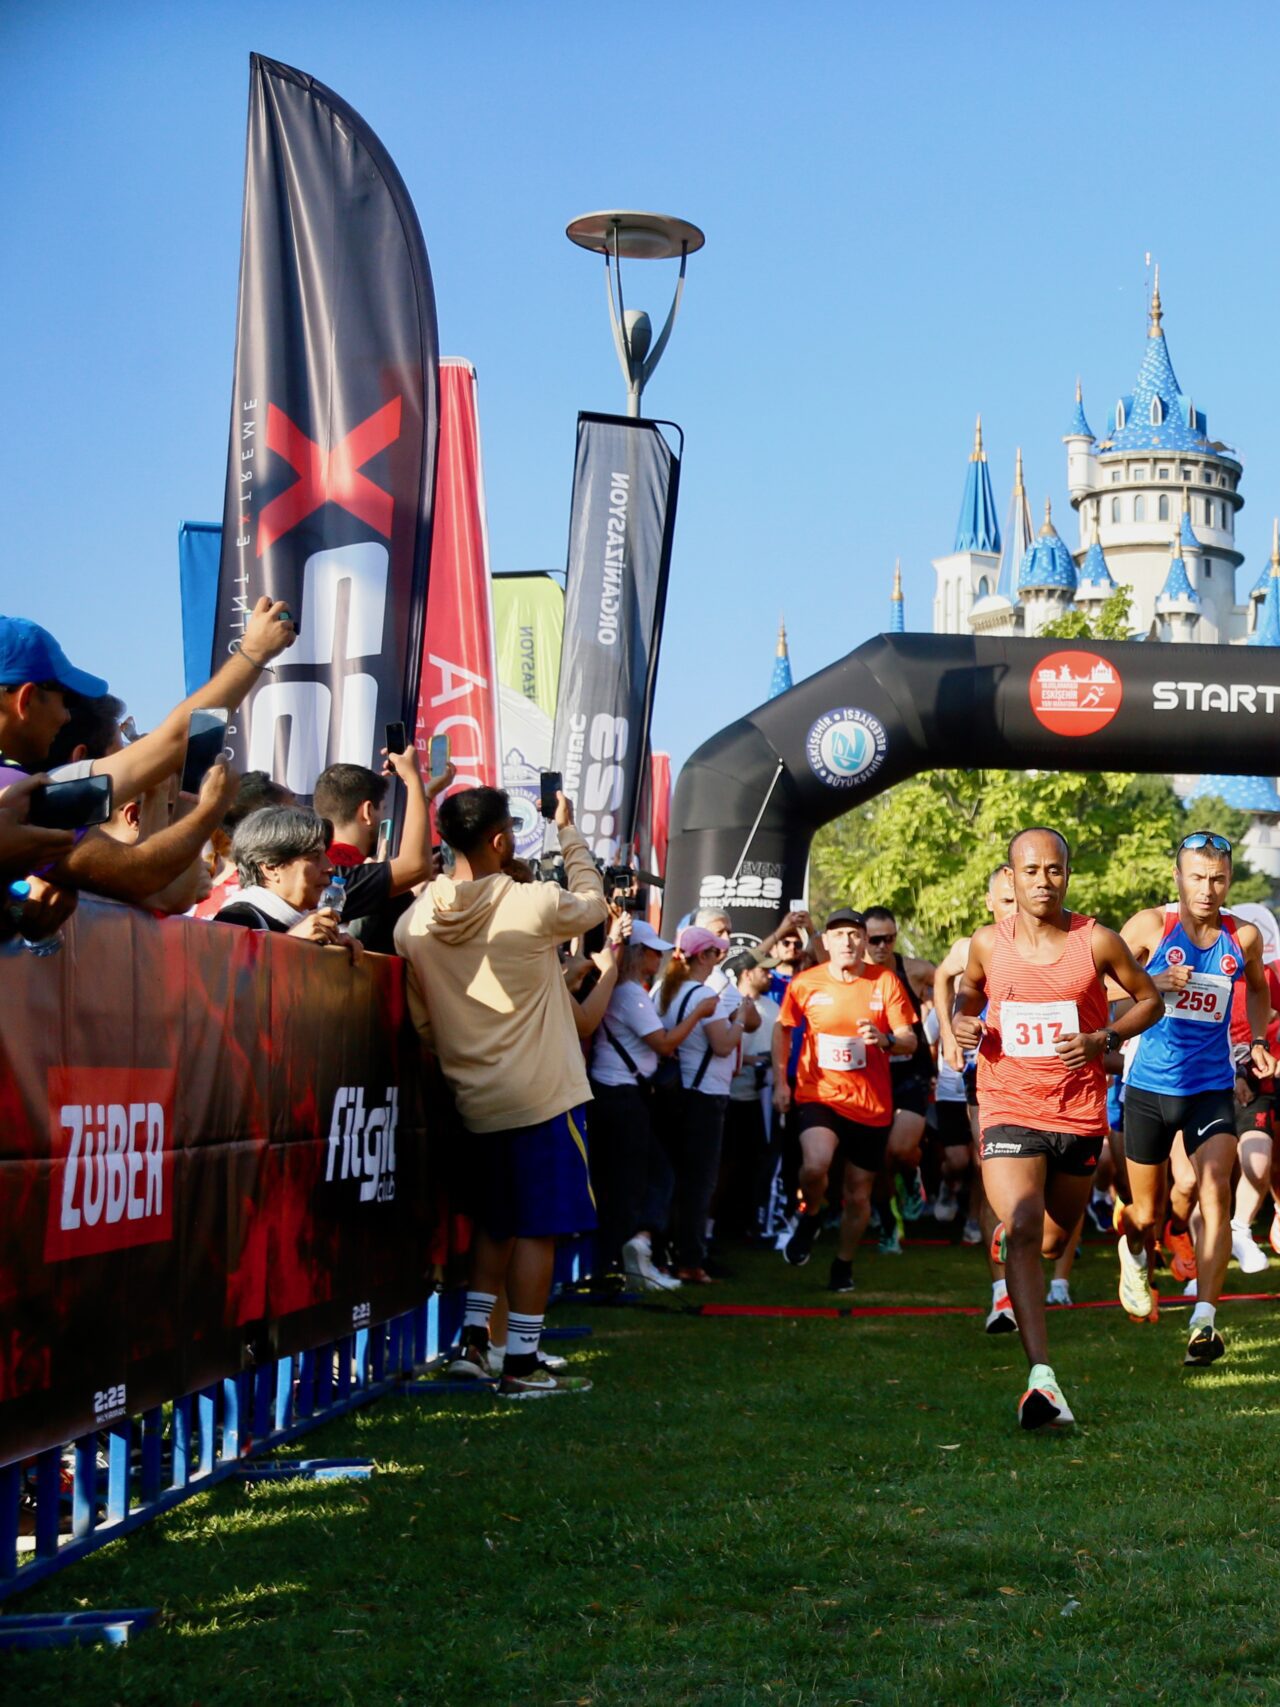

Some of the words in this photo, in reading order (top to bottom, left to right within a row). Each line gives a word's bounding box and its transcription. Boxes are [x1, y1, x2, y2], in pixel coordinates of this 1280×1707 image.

[699, 874, 783, 899] 2:23
[1175, 989, 1218, 1013] 259
[1015, 1022, 1063, 1045] 317
[832, 1049, 853, 1063] 35
[61, 1102, 164, 1231] ZÜBER
[94, 1383, 126, 1413] 2:23
